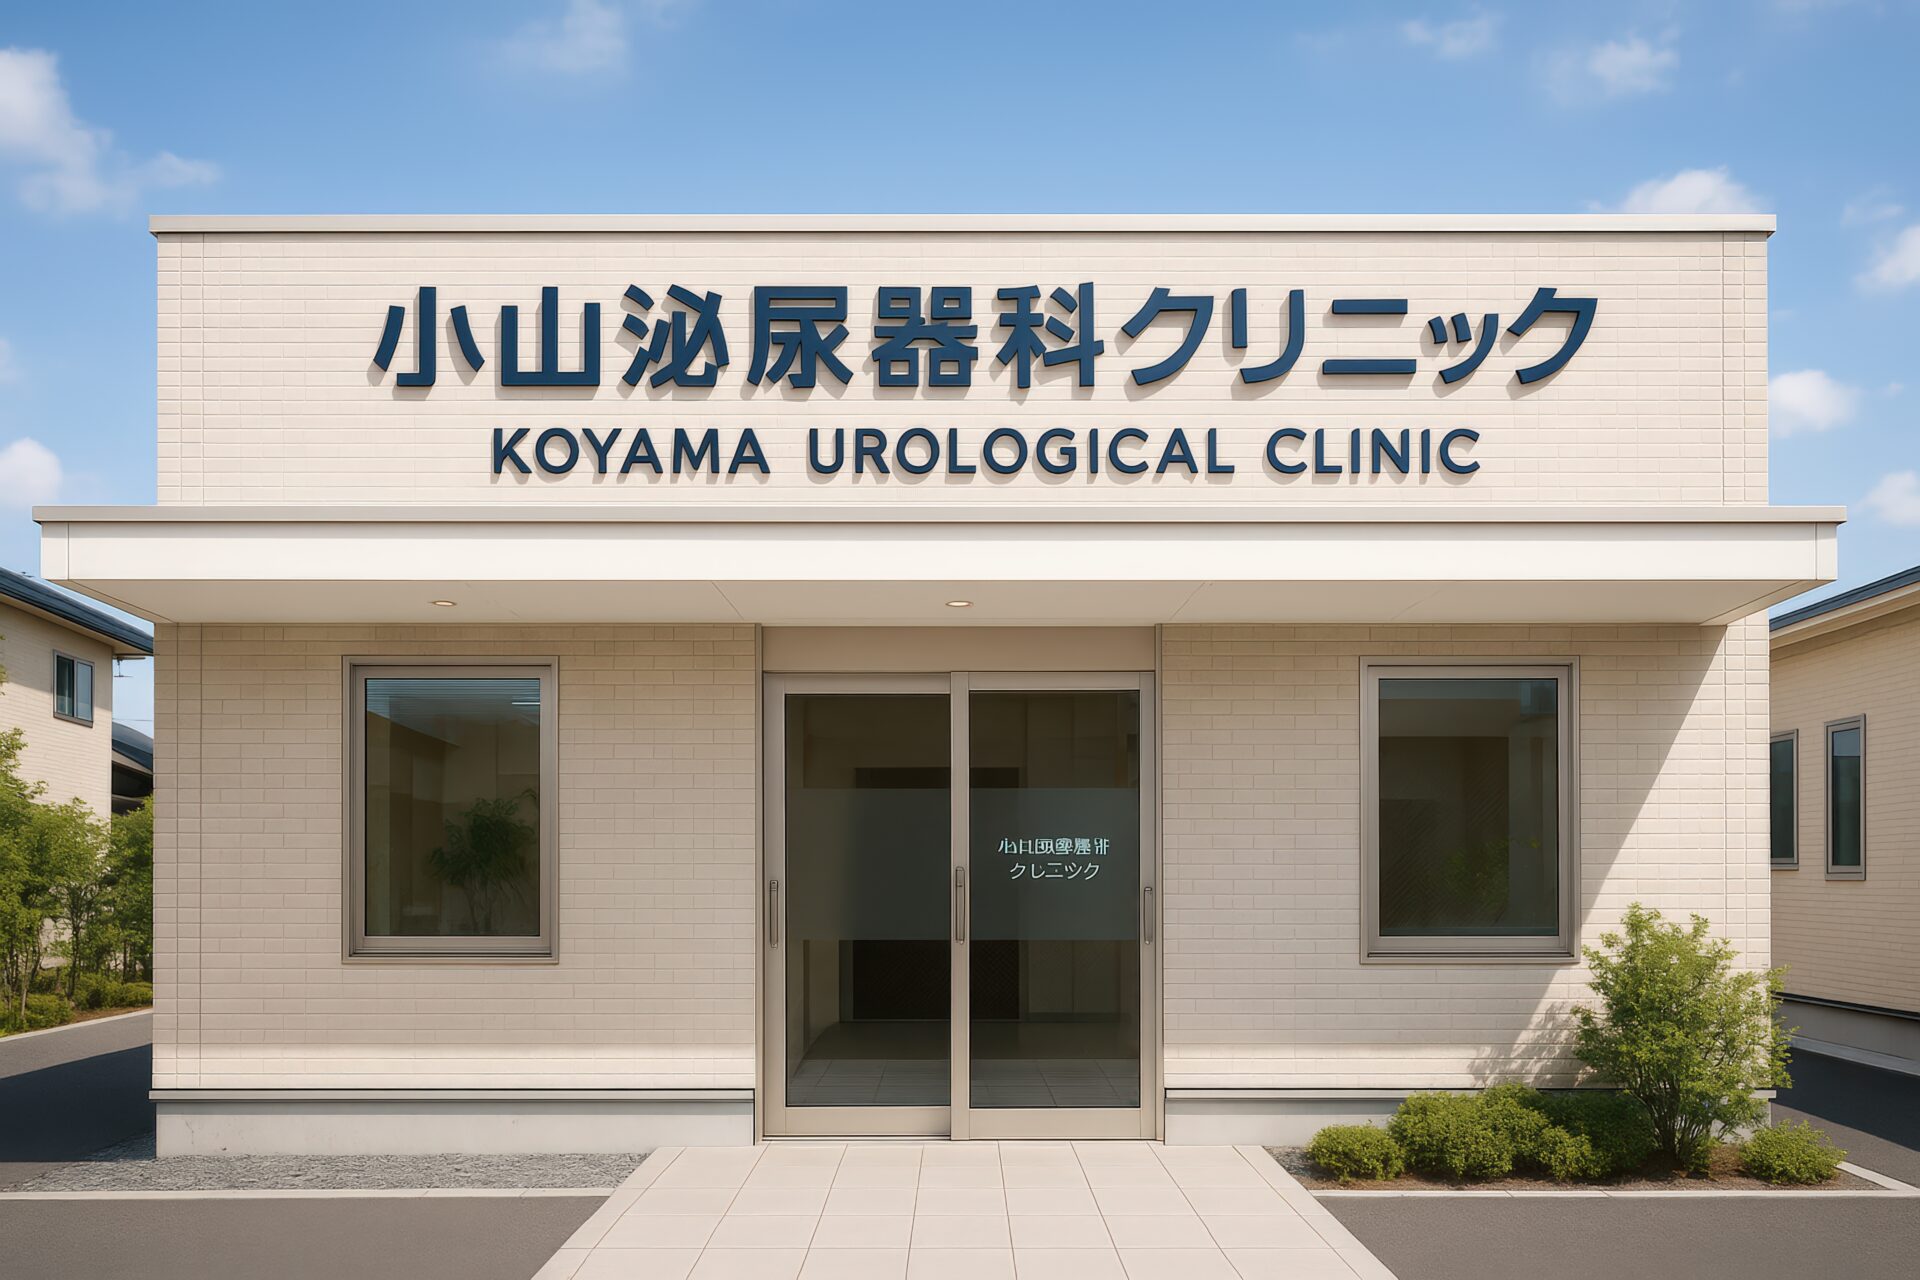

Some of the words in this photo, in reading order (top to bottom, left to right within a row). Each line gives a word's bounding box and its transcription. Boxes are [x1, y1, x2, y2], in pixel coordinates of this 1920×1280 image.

[373, 281, 1598, 388] 小山泌尿器科クリニック
[493, 427, 769, 474] KOYAMA
[810, 427, 1234, 474] UROLOGICAL
[1266, 427, 1480, 474] CLINIC
